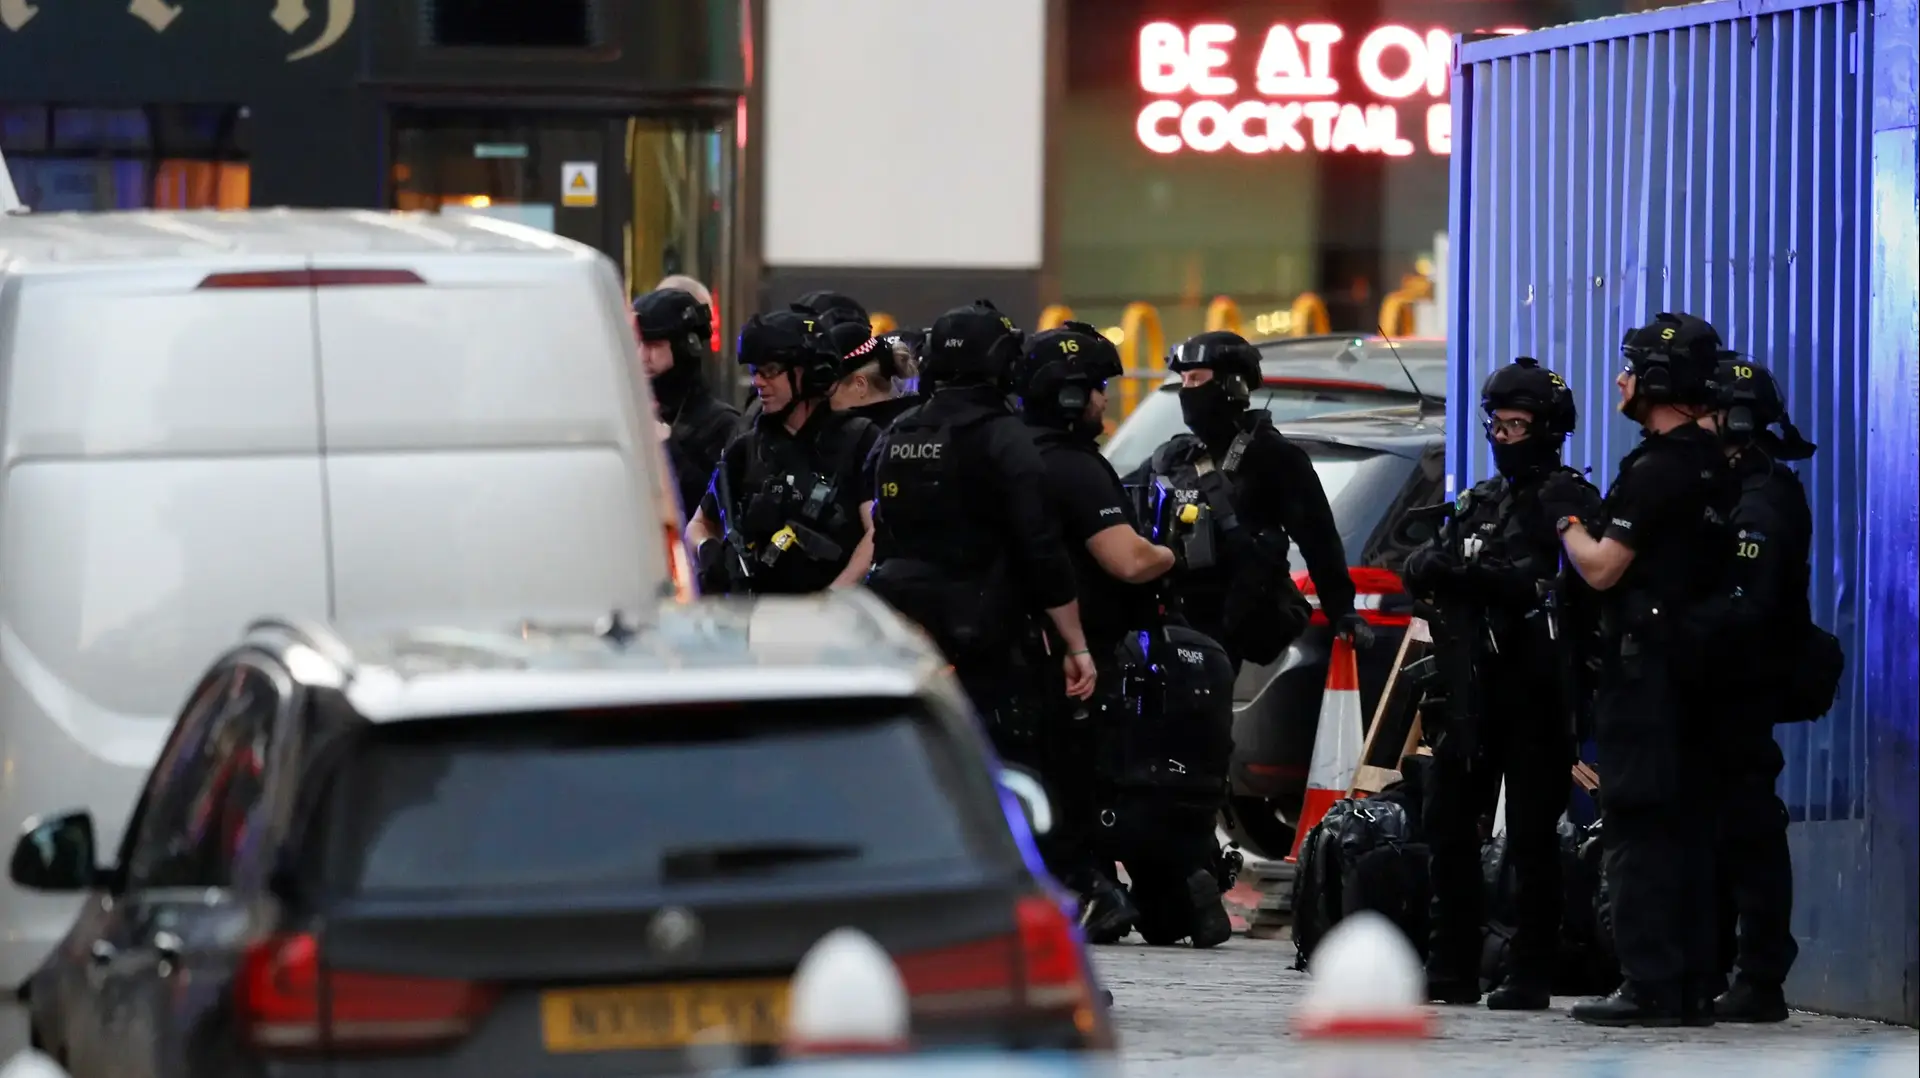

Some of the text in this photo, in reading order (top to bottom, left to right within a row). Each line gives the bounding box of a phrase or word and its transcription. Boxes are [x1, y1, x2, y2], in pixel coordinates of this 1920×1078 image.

[1138, 22, 1239, 97] BE
[1256, 24, 1343, 97] AT
[1137, 100, 1414, 156] COCKTAIL
[804, 320, 815, 333] 7
[1660, 328, 1676, 341] 5
[944, 338, 964, 348] ARV
[1058, 339, 1080, 354] 16
[1731, 364, 1753, 380] 10
[890, 443, 943, 460] POLICE
[881, 482, 899, 497] 19
[1736, 541, 1760, 559] 10
[1177, 648, 1204, 661] POLICE
